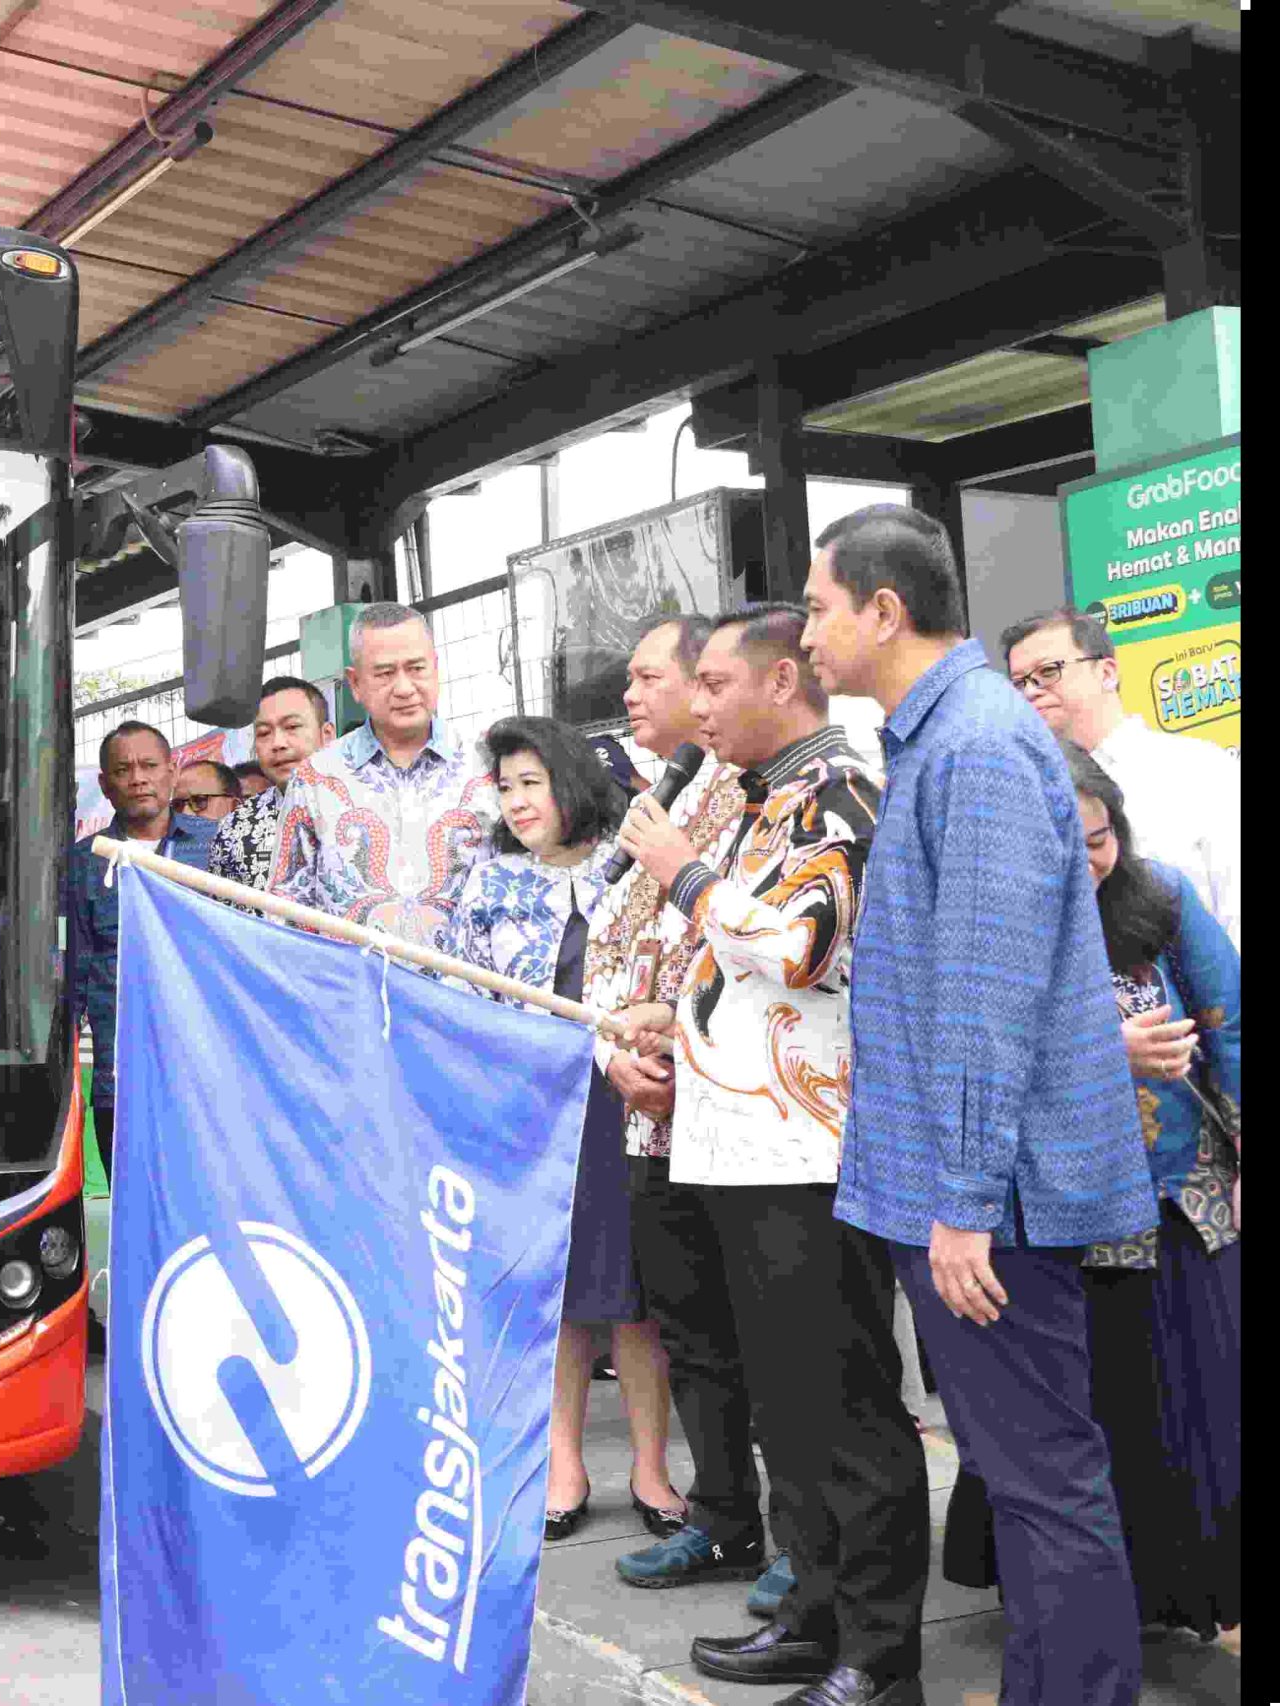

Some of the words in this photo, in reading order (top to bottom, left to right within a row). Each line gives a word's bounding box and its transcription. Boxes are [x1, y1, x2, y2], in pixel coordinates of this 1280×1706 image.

[1126, 518, 1194, 550] Makan
[1108, 550, 1173, 582] Hemat
[1176, 544, 1190, 566] &
[1189, 643, 1214, 658] Baru
[377, 1165, 480, 1673] transjakarta
